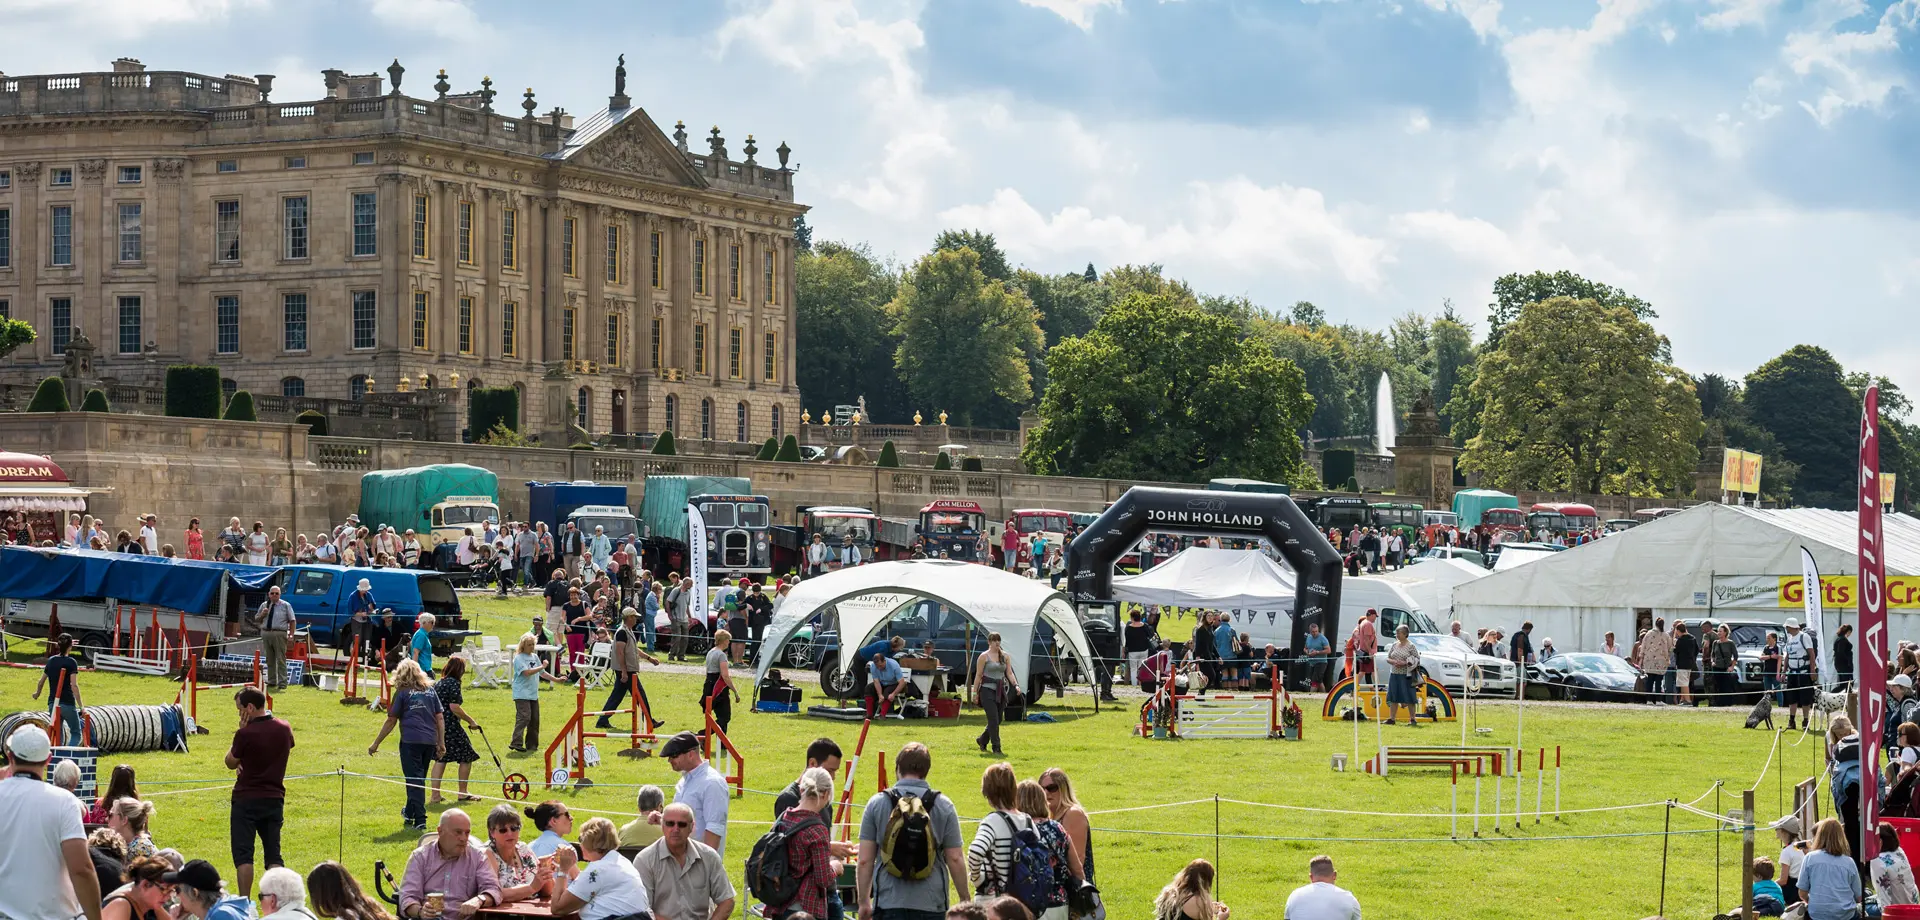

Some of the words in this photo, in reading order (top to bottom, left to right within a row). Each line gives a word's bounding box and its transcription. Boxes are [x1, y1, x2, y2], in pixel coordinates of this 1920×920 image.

[0, 467, 53, 476] DREAM
[1148, 510, 1188, 521] JOHN
[1192, 512, 1262, 525] HOLLAND
[1862, 407, 1883, 669] AGILITY
[1307, 586, 1329, 595] HOLLAND
[1783, 580, 1849, 603] Gts
[1887, 580, 1920, 603] Cr
